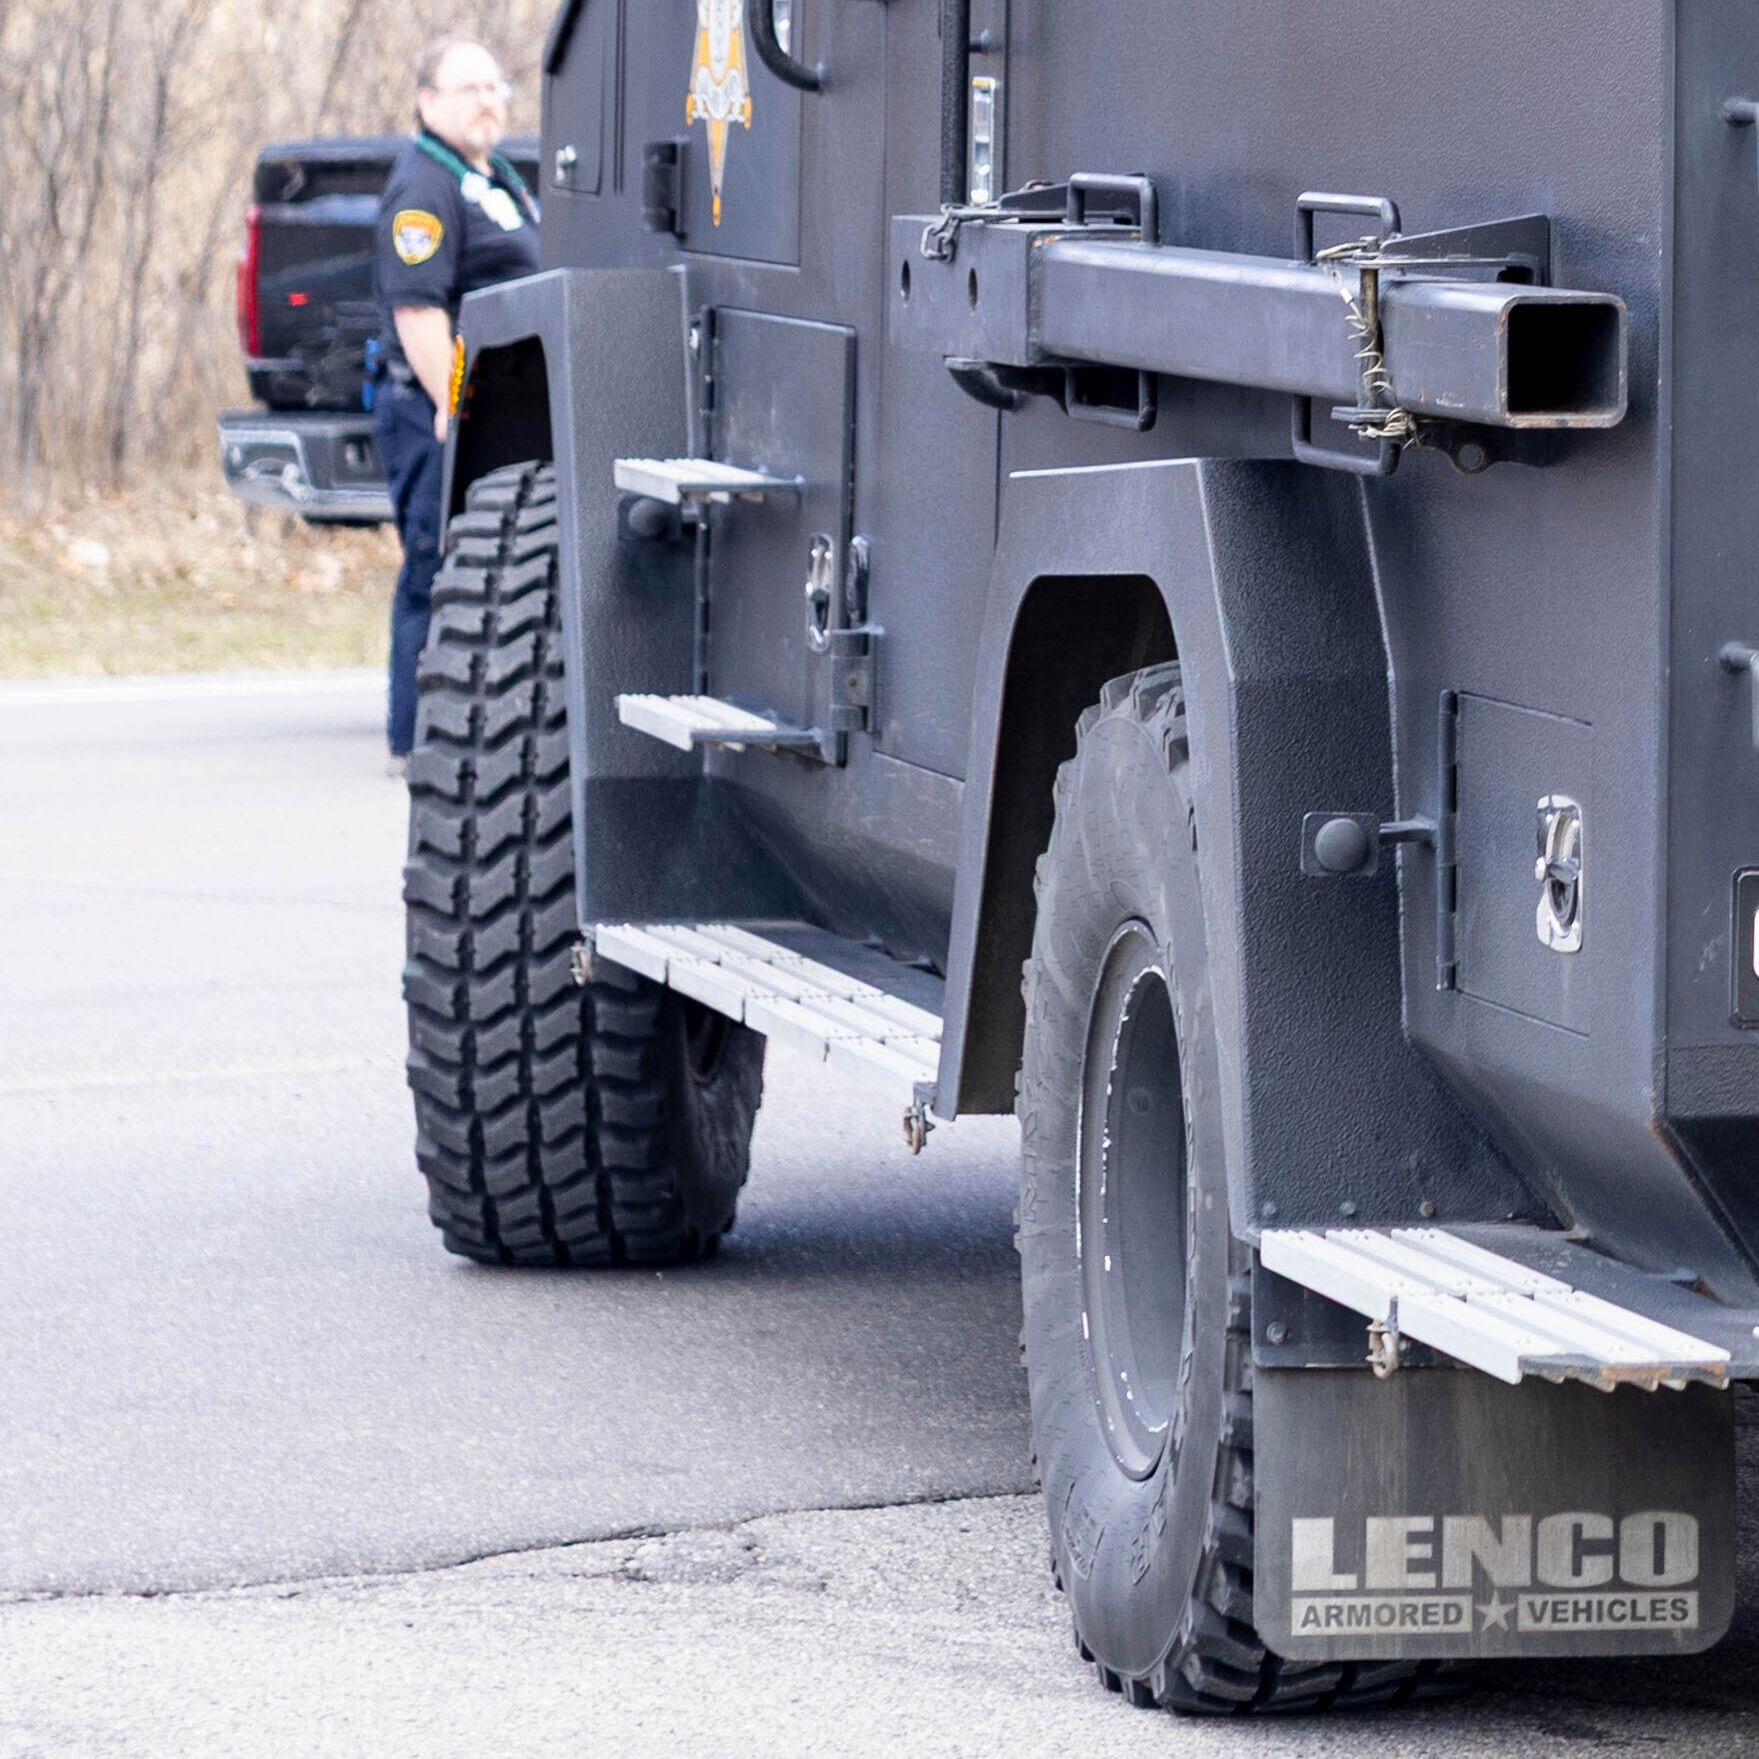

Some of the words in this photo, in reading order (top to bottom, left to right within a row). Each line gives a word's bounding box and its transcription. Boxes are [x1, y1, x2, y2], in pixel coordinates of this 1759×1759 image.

[1291, 1510, 1699, 1591] LENCO
[1300, 1602, 1463, 1629] ARMORED
[1527, 1597, 1690, 1624] VEHICLES
